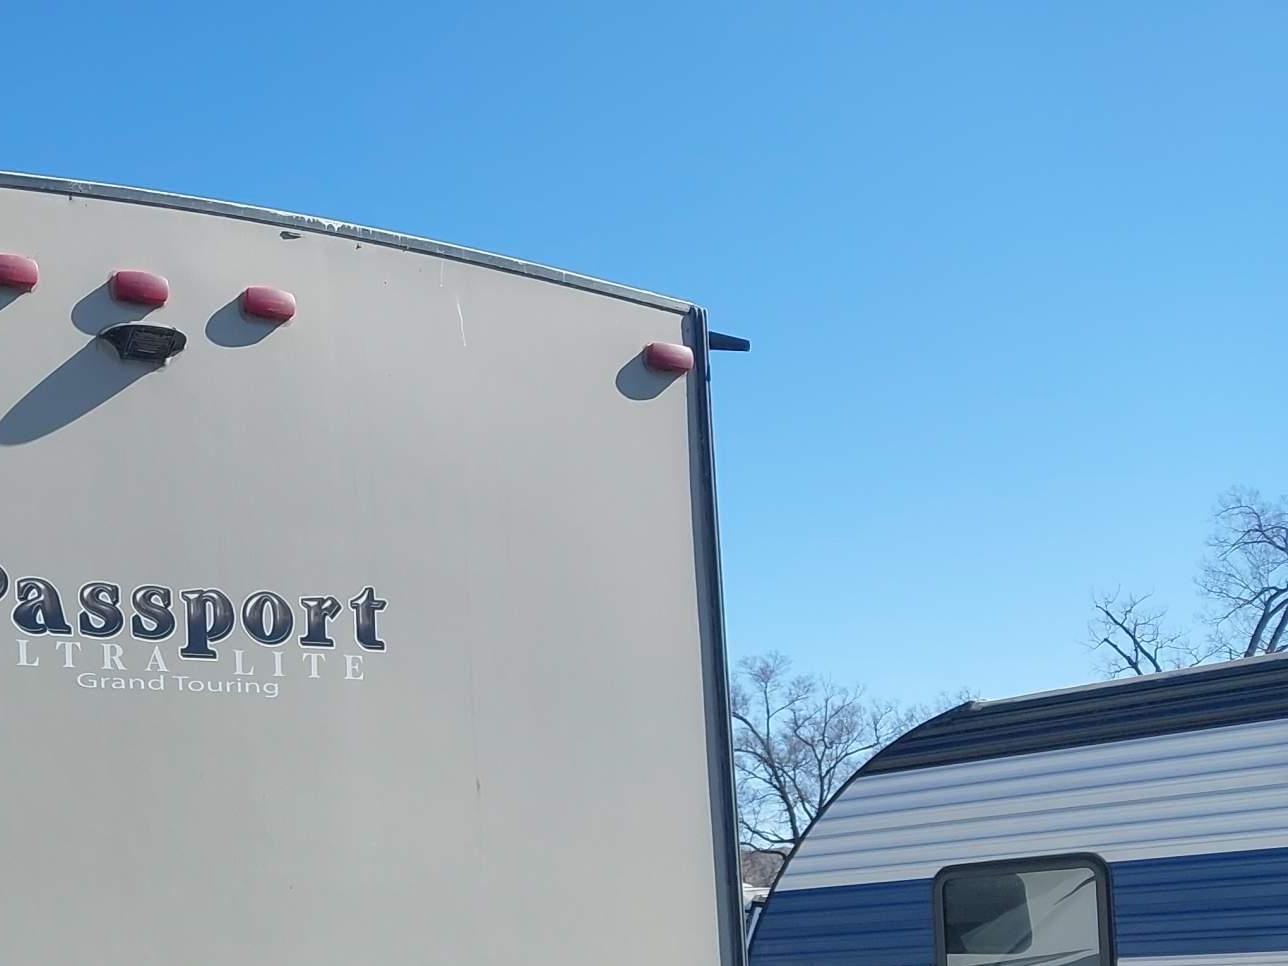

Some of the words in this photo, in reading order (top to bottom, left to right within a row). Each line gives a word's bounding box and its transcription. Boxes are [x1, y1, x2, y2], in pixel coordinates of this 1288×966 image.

[233, 648, 366, 681] LITE
[76, 672, 167, 693] Grand
[170, 674, 280, 698] Touring
